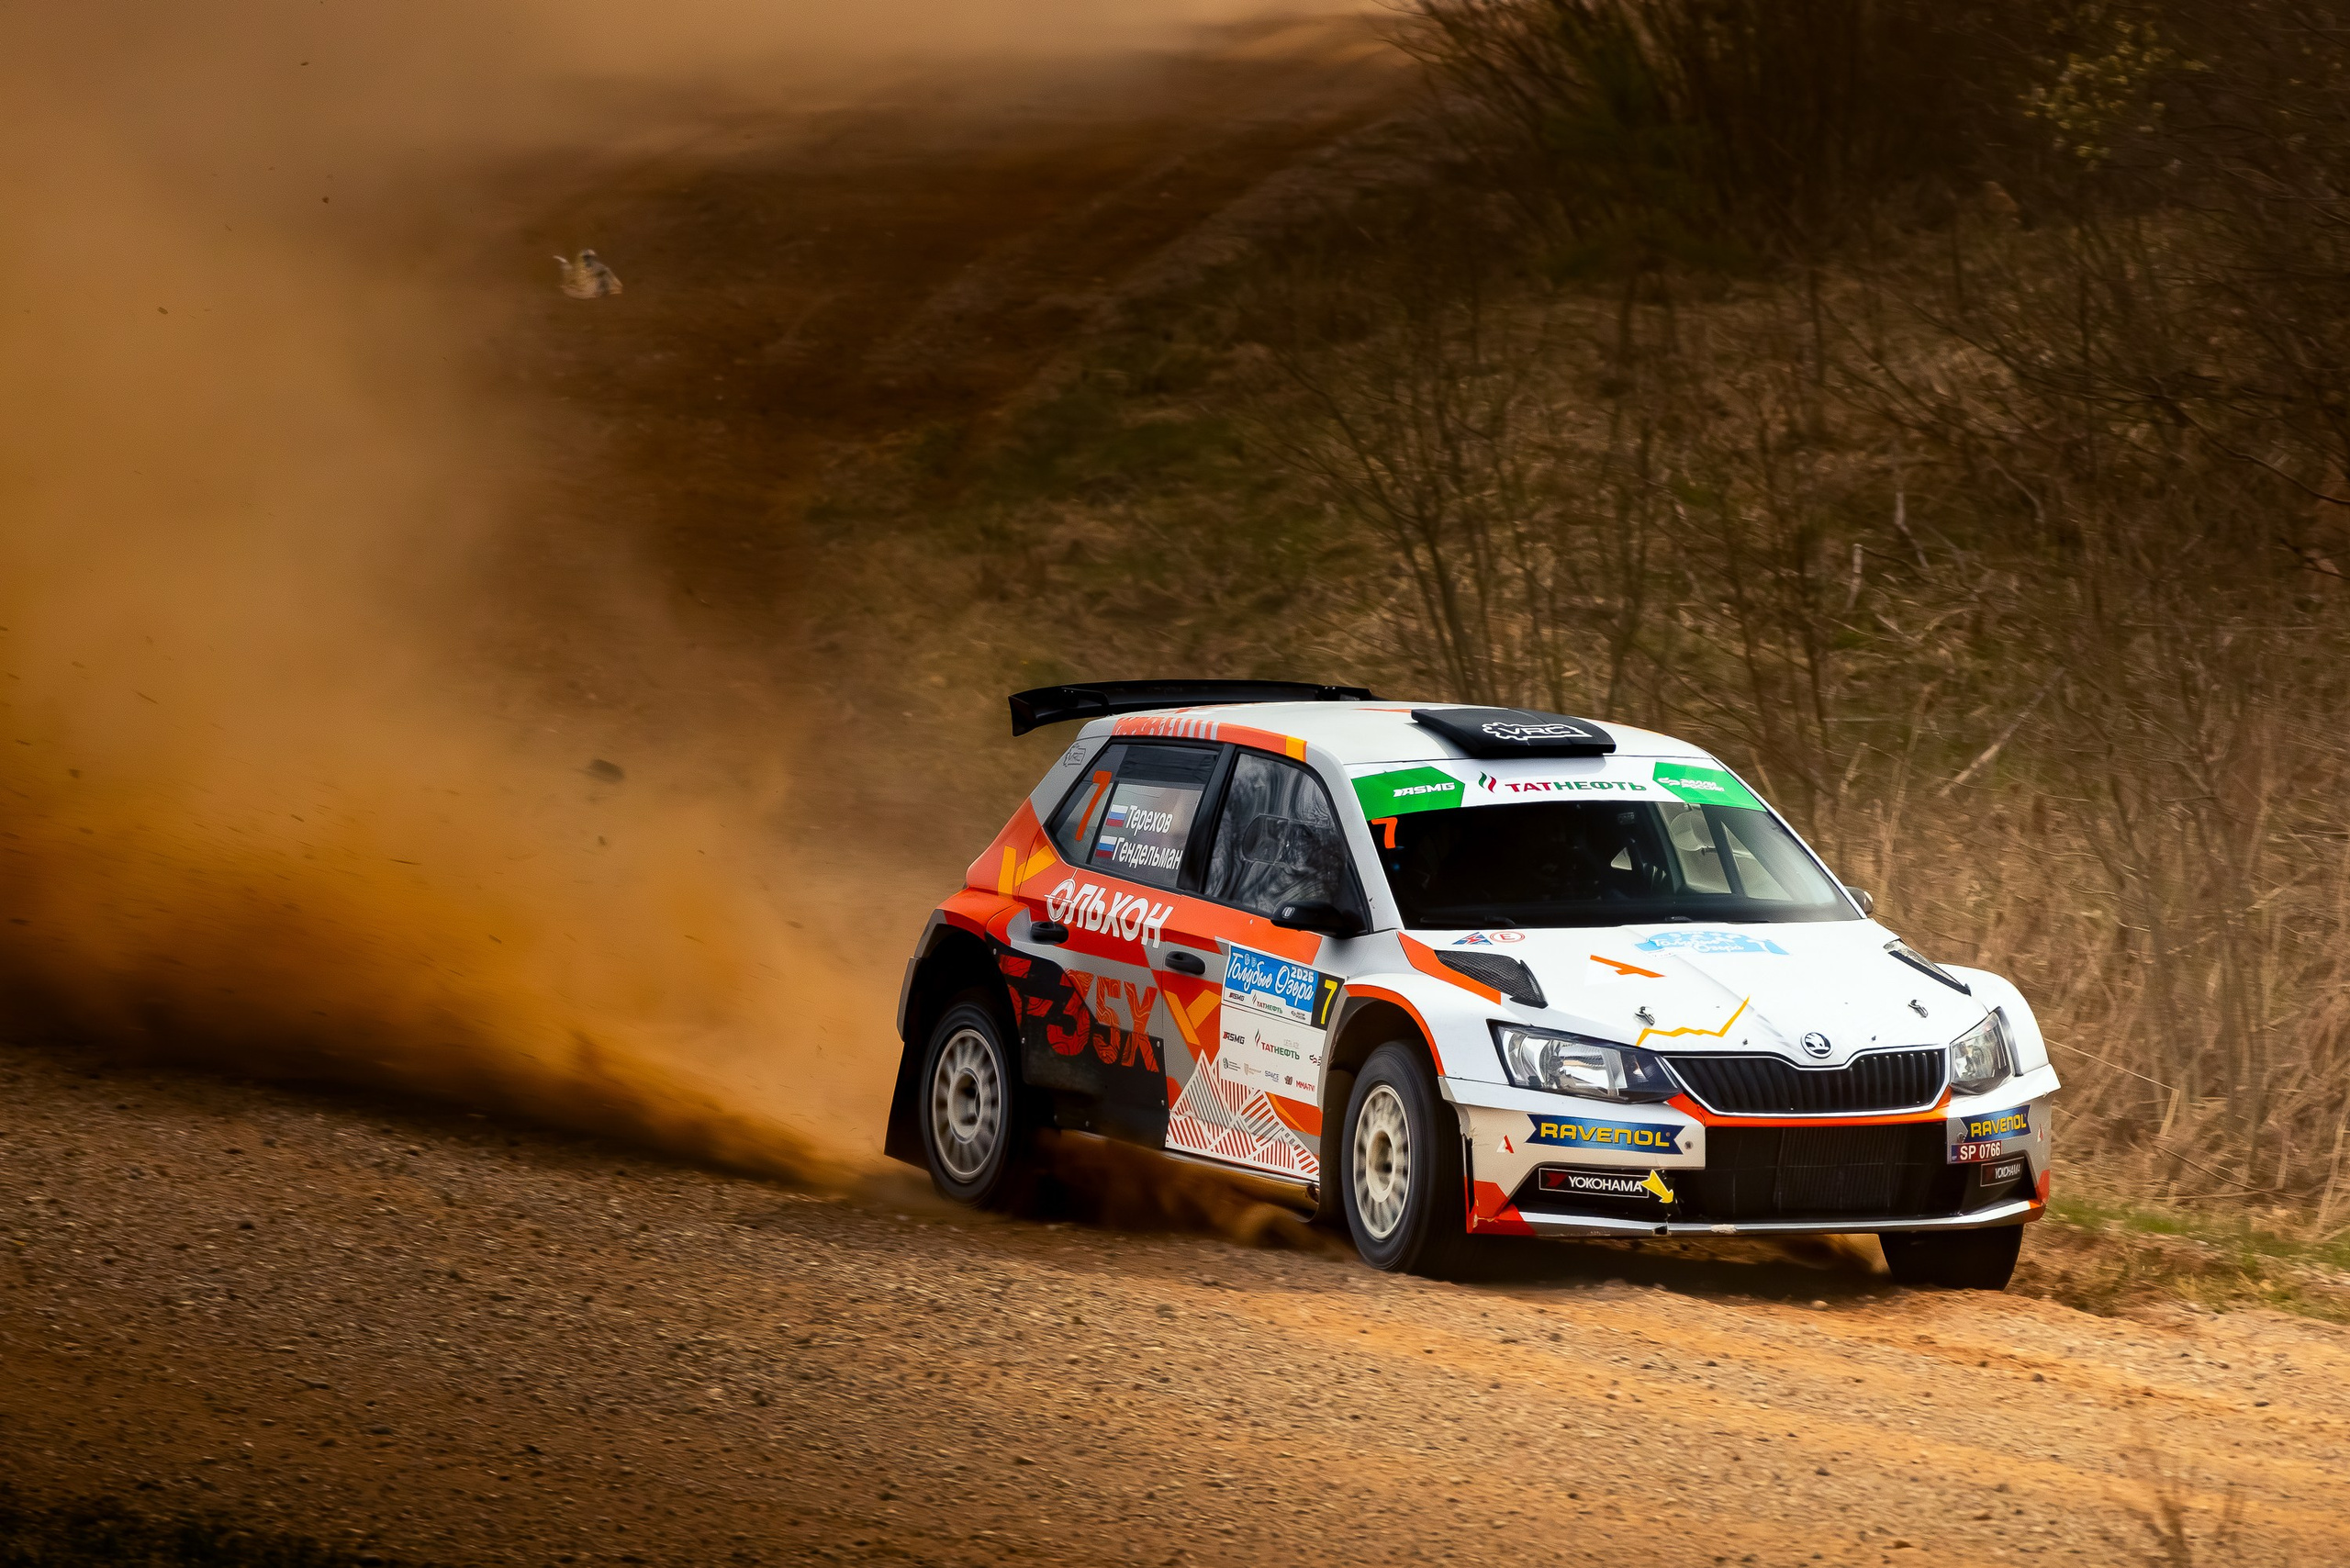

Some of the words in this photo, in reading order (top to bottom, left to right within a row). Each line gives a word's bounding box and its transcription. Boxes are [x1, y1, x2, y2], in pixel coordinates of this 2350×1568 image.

[1497, 726, 1571, 735] VRC
[1505, 781, 1647, 793] ТАТНЕФТЬ
[1075, 770, 1112, 841] 7
[1126, 805, 1173, 836] Терехов
[1371, 816, 1398, 849] 7
[1112, 837, 1183, 870] Гендельман
[1046, 878, 1174, 949] ОЛЬХОН
[1227, 952, 1273, 991] Голубые
[1275, 965, 1315, 1006] Озера
[1291, 966, 1315, 982] 2026
[1257, 1001, 1283, 1014] ТАТНЕФТЬ
[1320, 979, 1338, 1025] 7
[1261, 1041, 1300, 1060] ТАТНЕФТЬ
[1540, 1122, 1670, 1148] RAVENOL
[1970, 1113, 2027, 1137] RAVENOL
[1960, 1145, 1976, 1160] SP
[1979, 1142, 2001, 1159] 0766
[1568, 1175, 1643, 1193] YOKOHAMA
